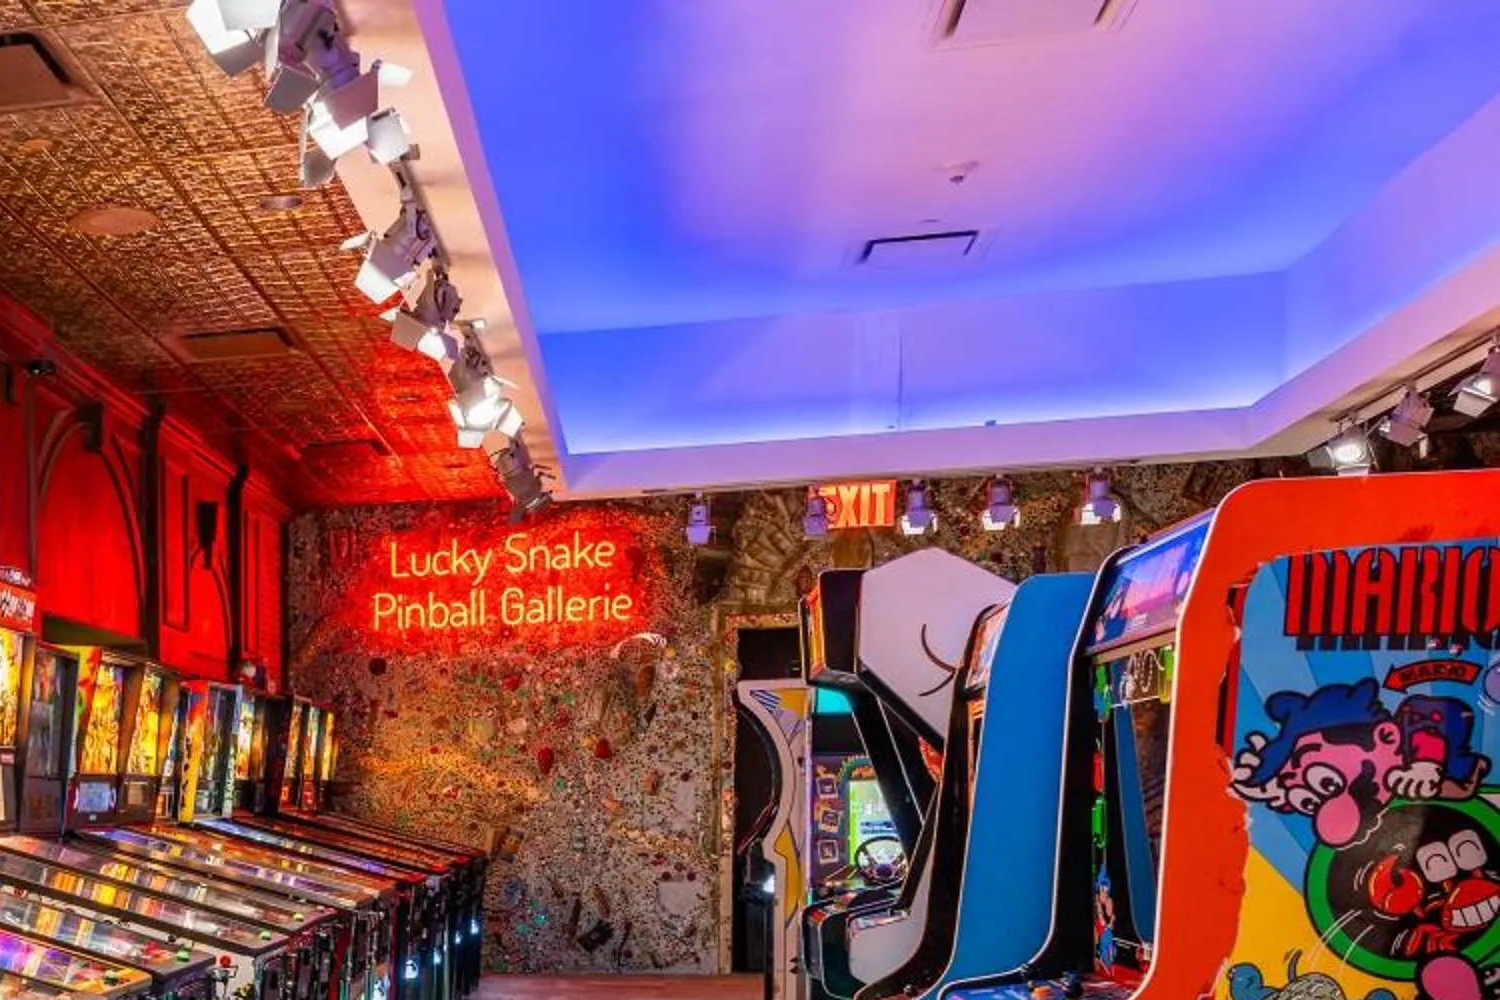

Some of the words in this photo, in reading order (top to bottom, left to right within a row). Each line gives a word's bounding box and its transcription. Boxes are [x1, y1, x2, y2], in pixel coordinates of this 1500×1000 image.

[390, 538, 493, 586] Lucky
[505, 531, 615, 573] Snake
[373, 589, 486, 630] Pinball
[500, 584, 633, 625] Gallerie
[1284, 545, 1500, 636] MARIO
